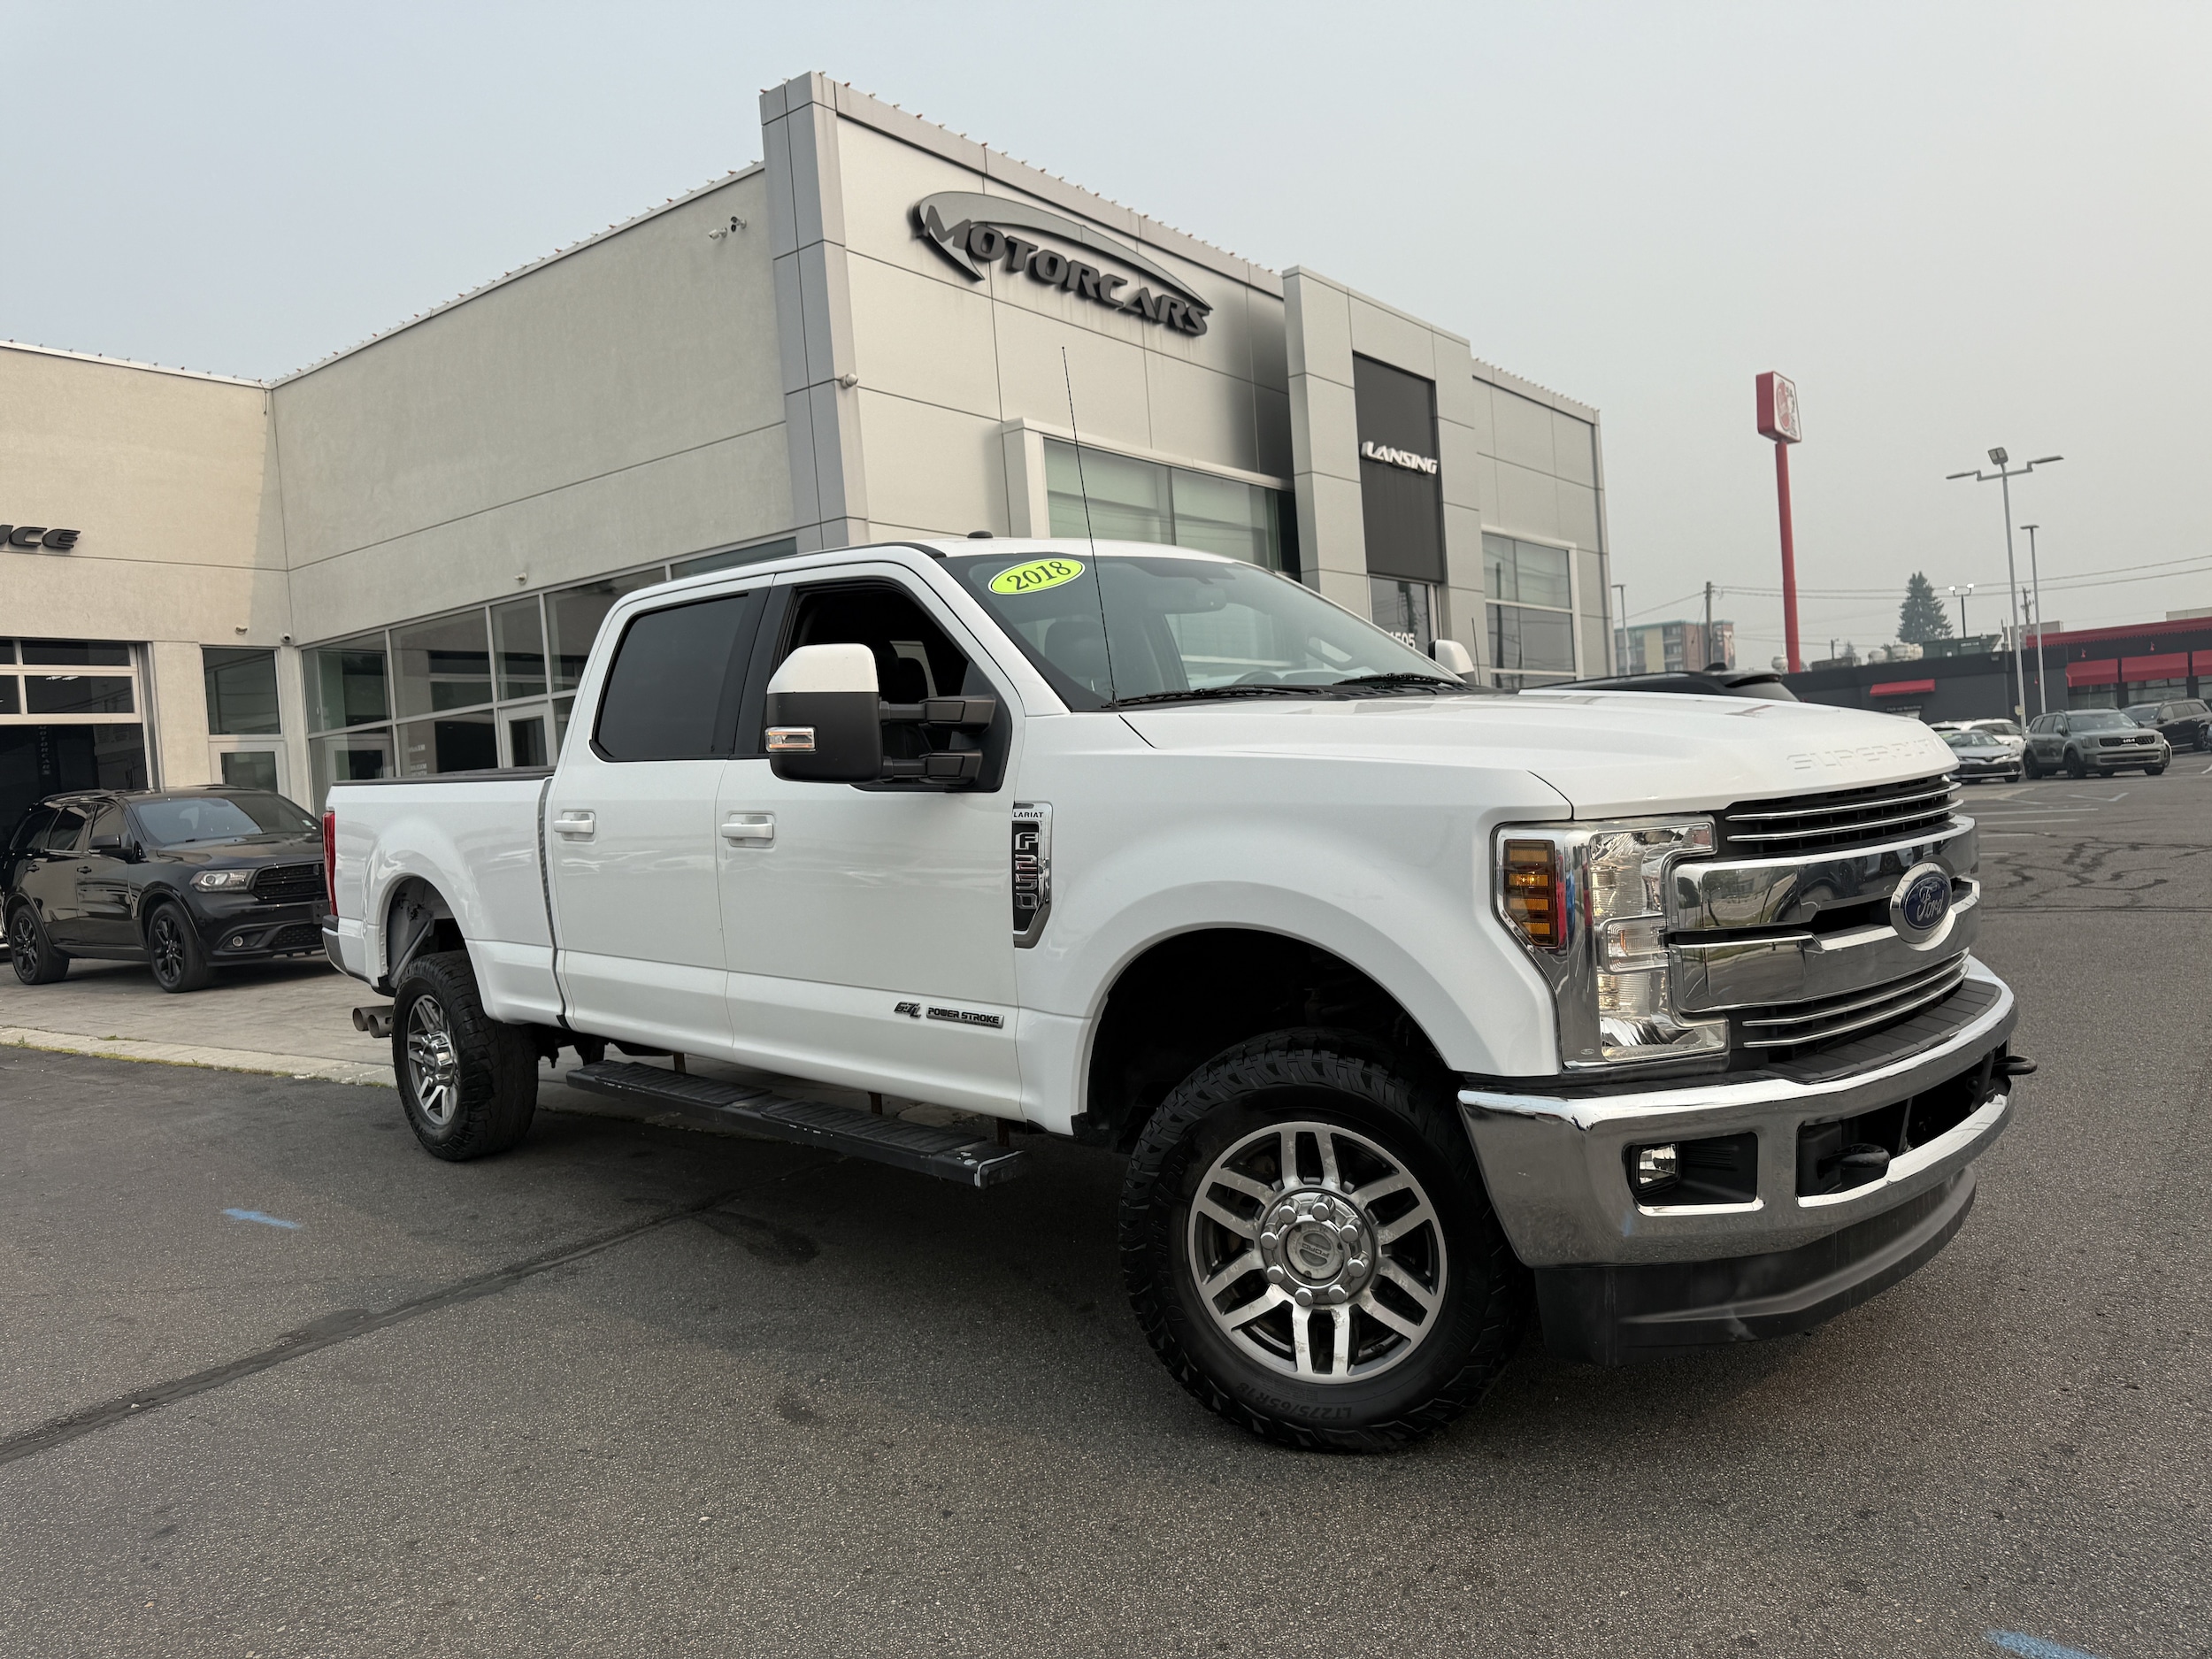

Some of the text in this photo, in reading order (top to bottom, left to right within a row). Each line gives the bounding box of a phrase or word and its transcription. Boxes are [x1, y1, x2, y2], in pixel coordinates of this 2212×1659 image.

[917, 204, 1210, 336] MOTORCARS
[1362, 441, 1438, 474] LANSING
[1006, 561, 1071, 590] 2018
[1916, 884, 1945, 922] Ford
[927, 1007, 960, 1019] POWER
[961, 1011, 1000, 1025] STROKE
[1302, 1242, 1330, 1258] FORD
